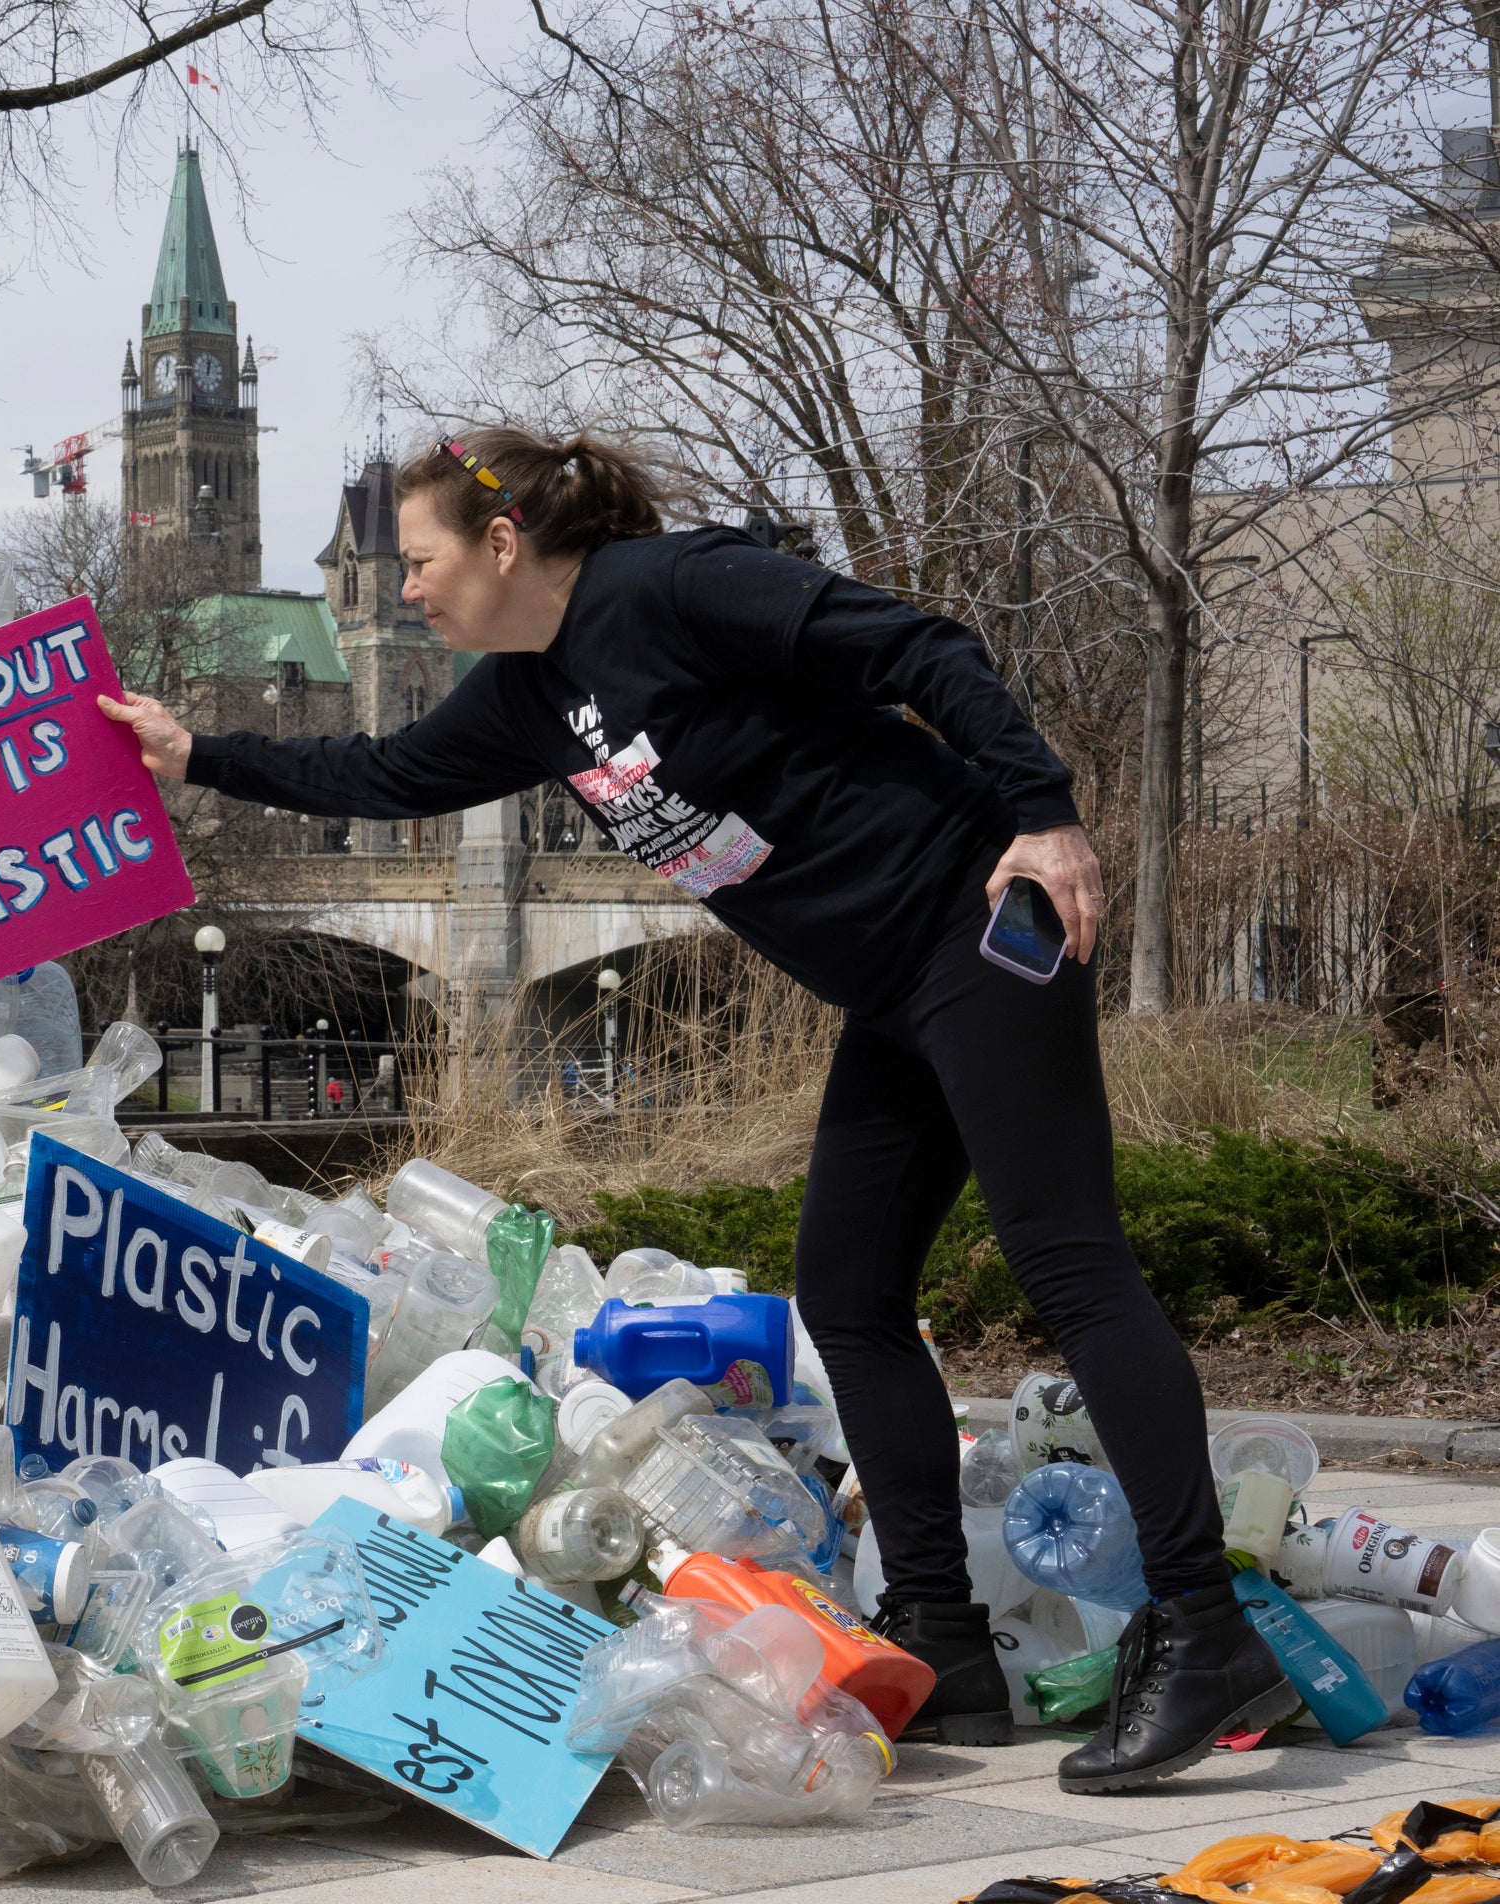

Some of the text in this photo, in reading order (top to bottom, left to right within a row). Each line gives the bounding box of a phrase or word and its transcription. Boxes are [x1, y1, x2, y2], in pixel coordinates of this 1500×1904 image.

[0, 719, 68, 794] IS
[659, 792, 697, 823] ME
[48, 1165, 321, 1377] Plastic
[8, 1315, 188, 1470] Harms
[1354, 1529, 1368, 1547] Astro
[1359, 1523, 1392, 1575] ORIGINAL
[233, 1612, 264, 1634] Mirabel
[273, 1594, 344, 1630] boston
[393, 1712, 488, 1795] est
